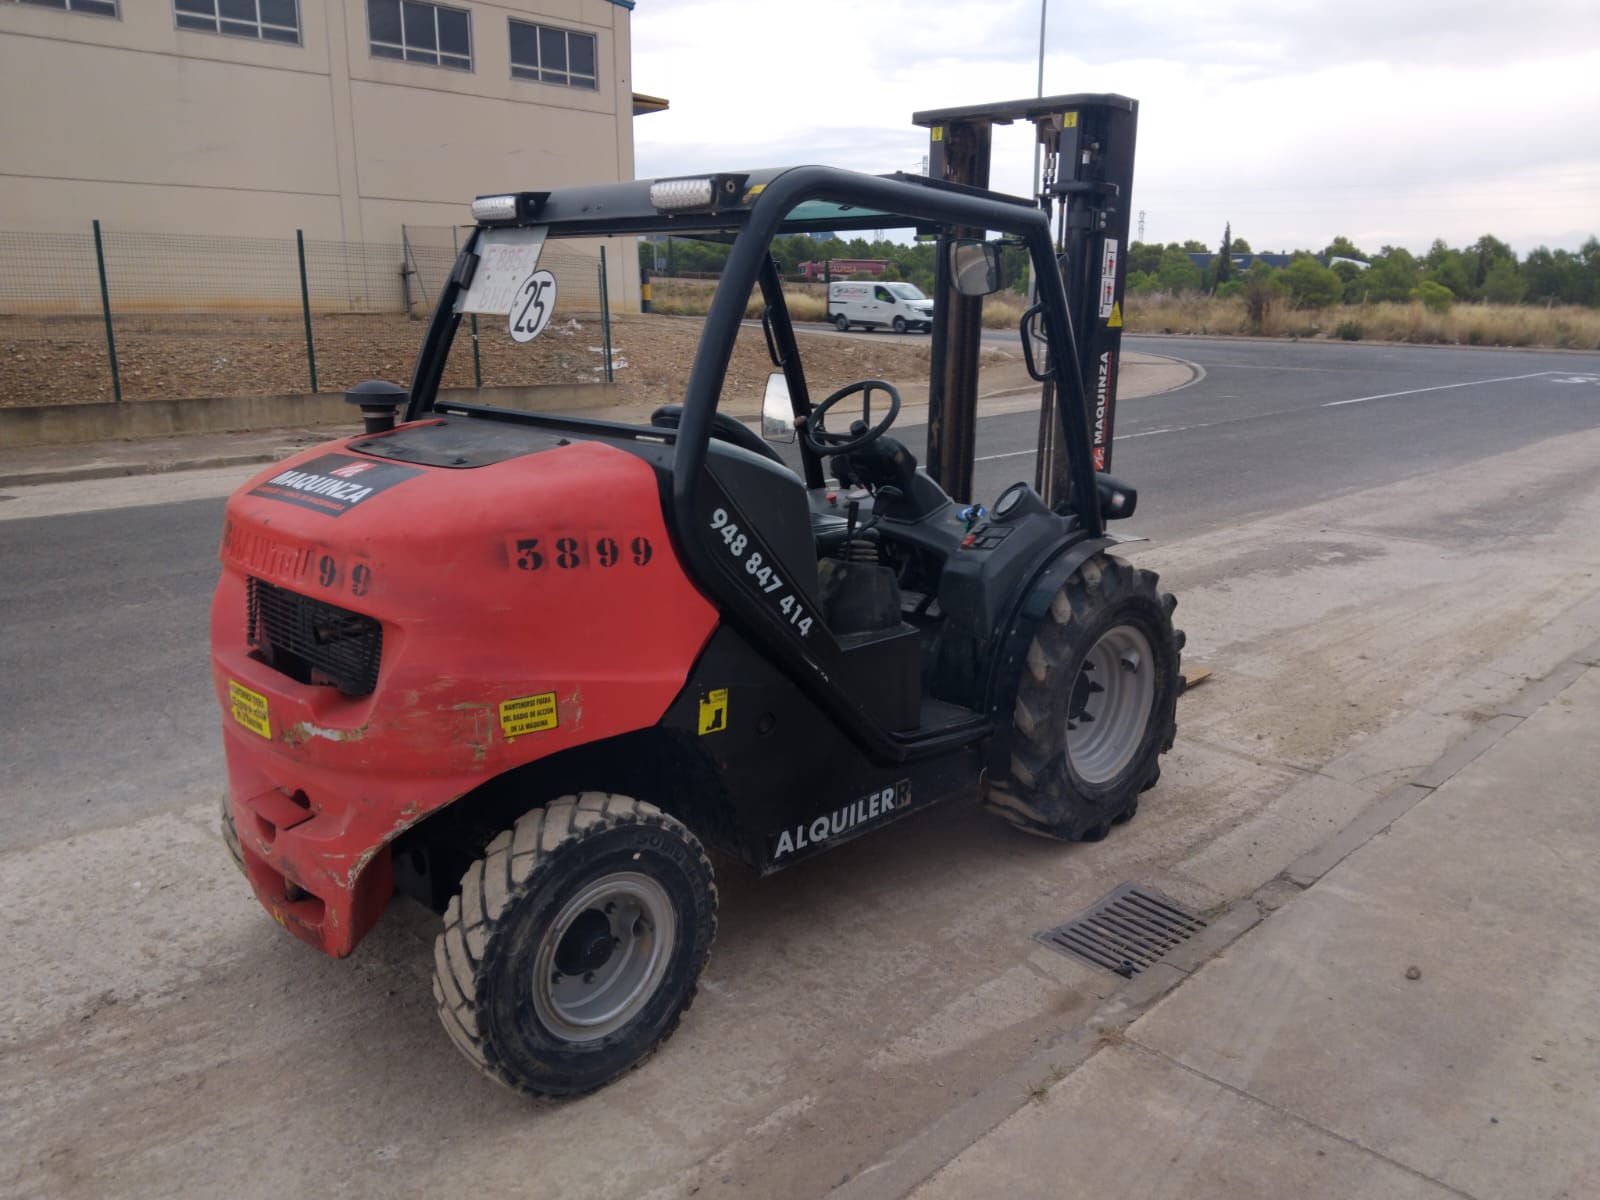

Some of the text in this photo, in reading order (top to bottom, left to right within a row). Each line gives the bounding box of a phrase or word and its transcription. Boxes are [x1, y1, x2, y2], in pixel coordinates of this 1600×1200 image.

[513, 280, 552, 334] 25
[1094, 351, 1109, 445] MAQUINZA
[268, 470, 374, 503] MAQUINZA
[515, 536, 653, 571] 3899
[709, 508, 815, 637] 948 847 414
[774, 787, 896, 859] ALQUILER
